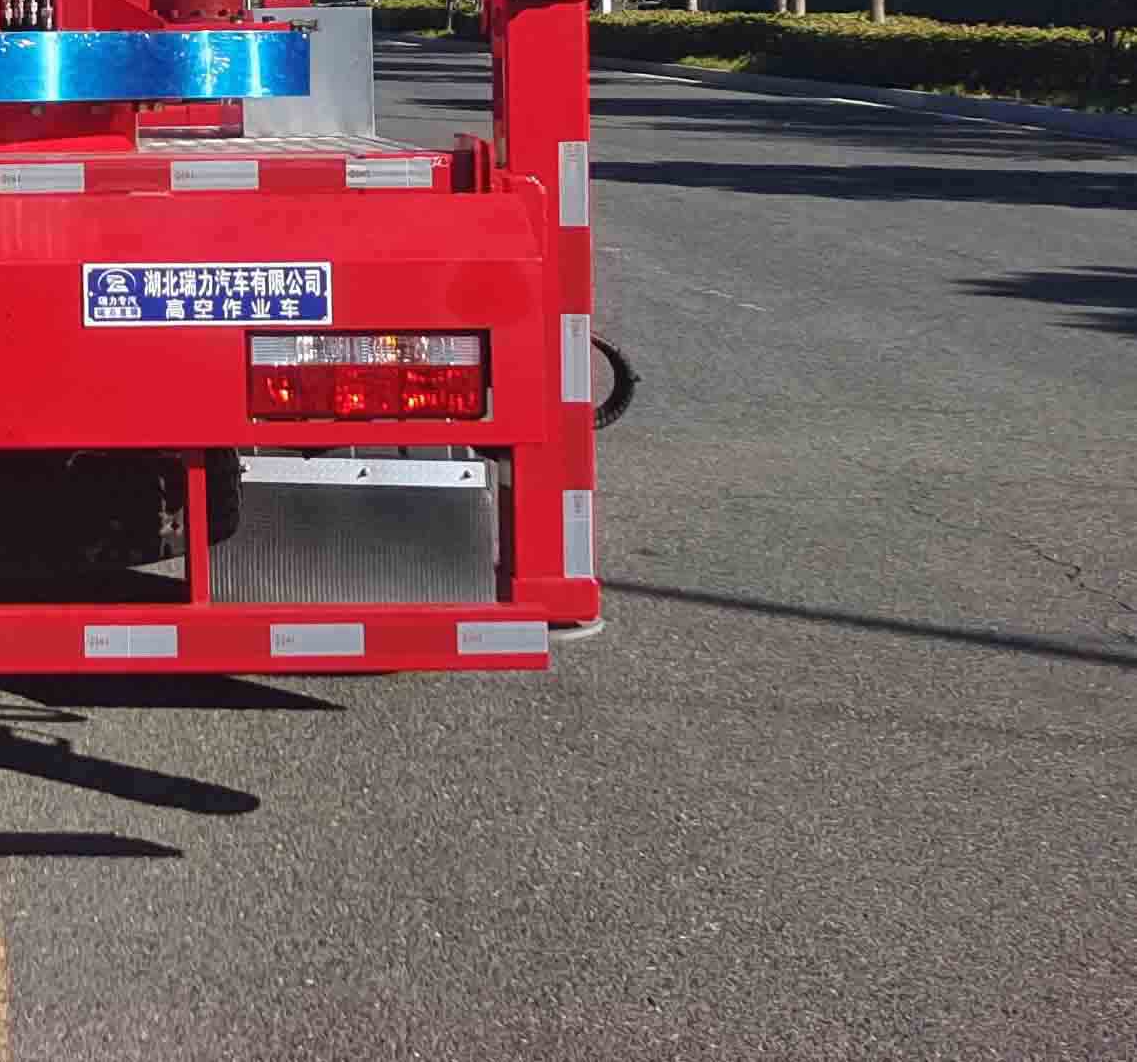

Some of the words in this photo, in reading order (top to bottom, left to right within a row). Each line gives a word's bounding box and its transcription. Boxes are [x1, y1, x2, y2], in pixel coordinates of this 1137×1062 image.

[143, 269, 322, 298] 湖北瑞力汽车有限公司
[165, 298, 300, 320] 高空作业车
